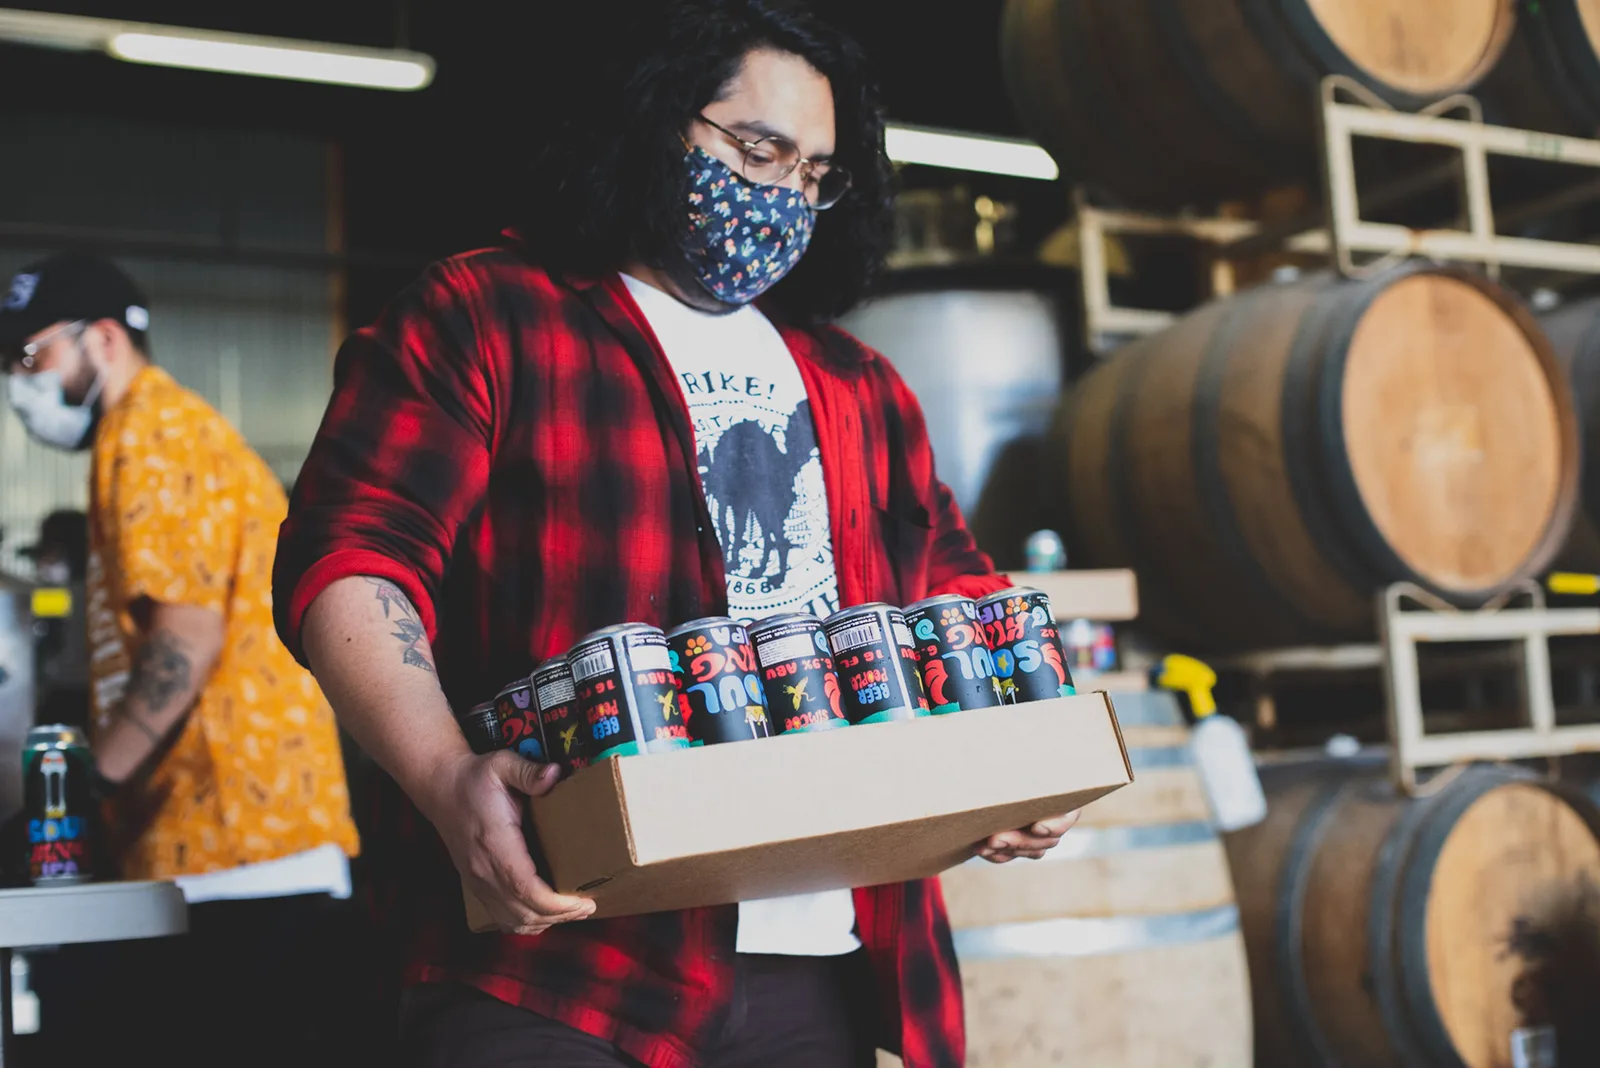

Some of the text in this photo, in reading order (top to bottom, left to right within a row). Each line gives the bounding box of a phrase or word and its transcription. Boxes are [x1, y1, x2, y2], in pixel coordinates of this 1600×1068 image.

[839, 655, 859, 668] FL
[863, 648, 885, 662] 16
[801, 657, 832, 672] 6.9%
[594, 679, 616, 694] 16
[849, 667, 889, 691] PEOPLE
[857, 683, 890, 705] BEER
[784, 709, 829, 731] SIMCOE
